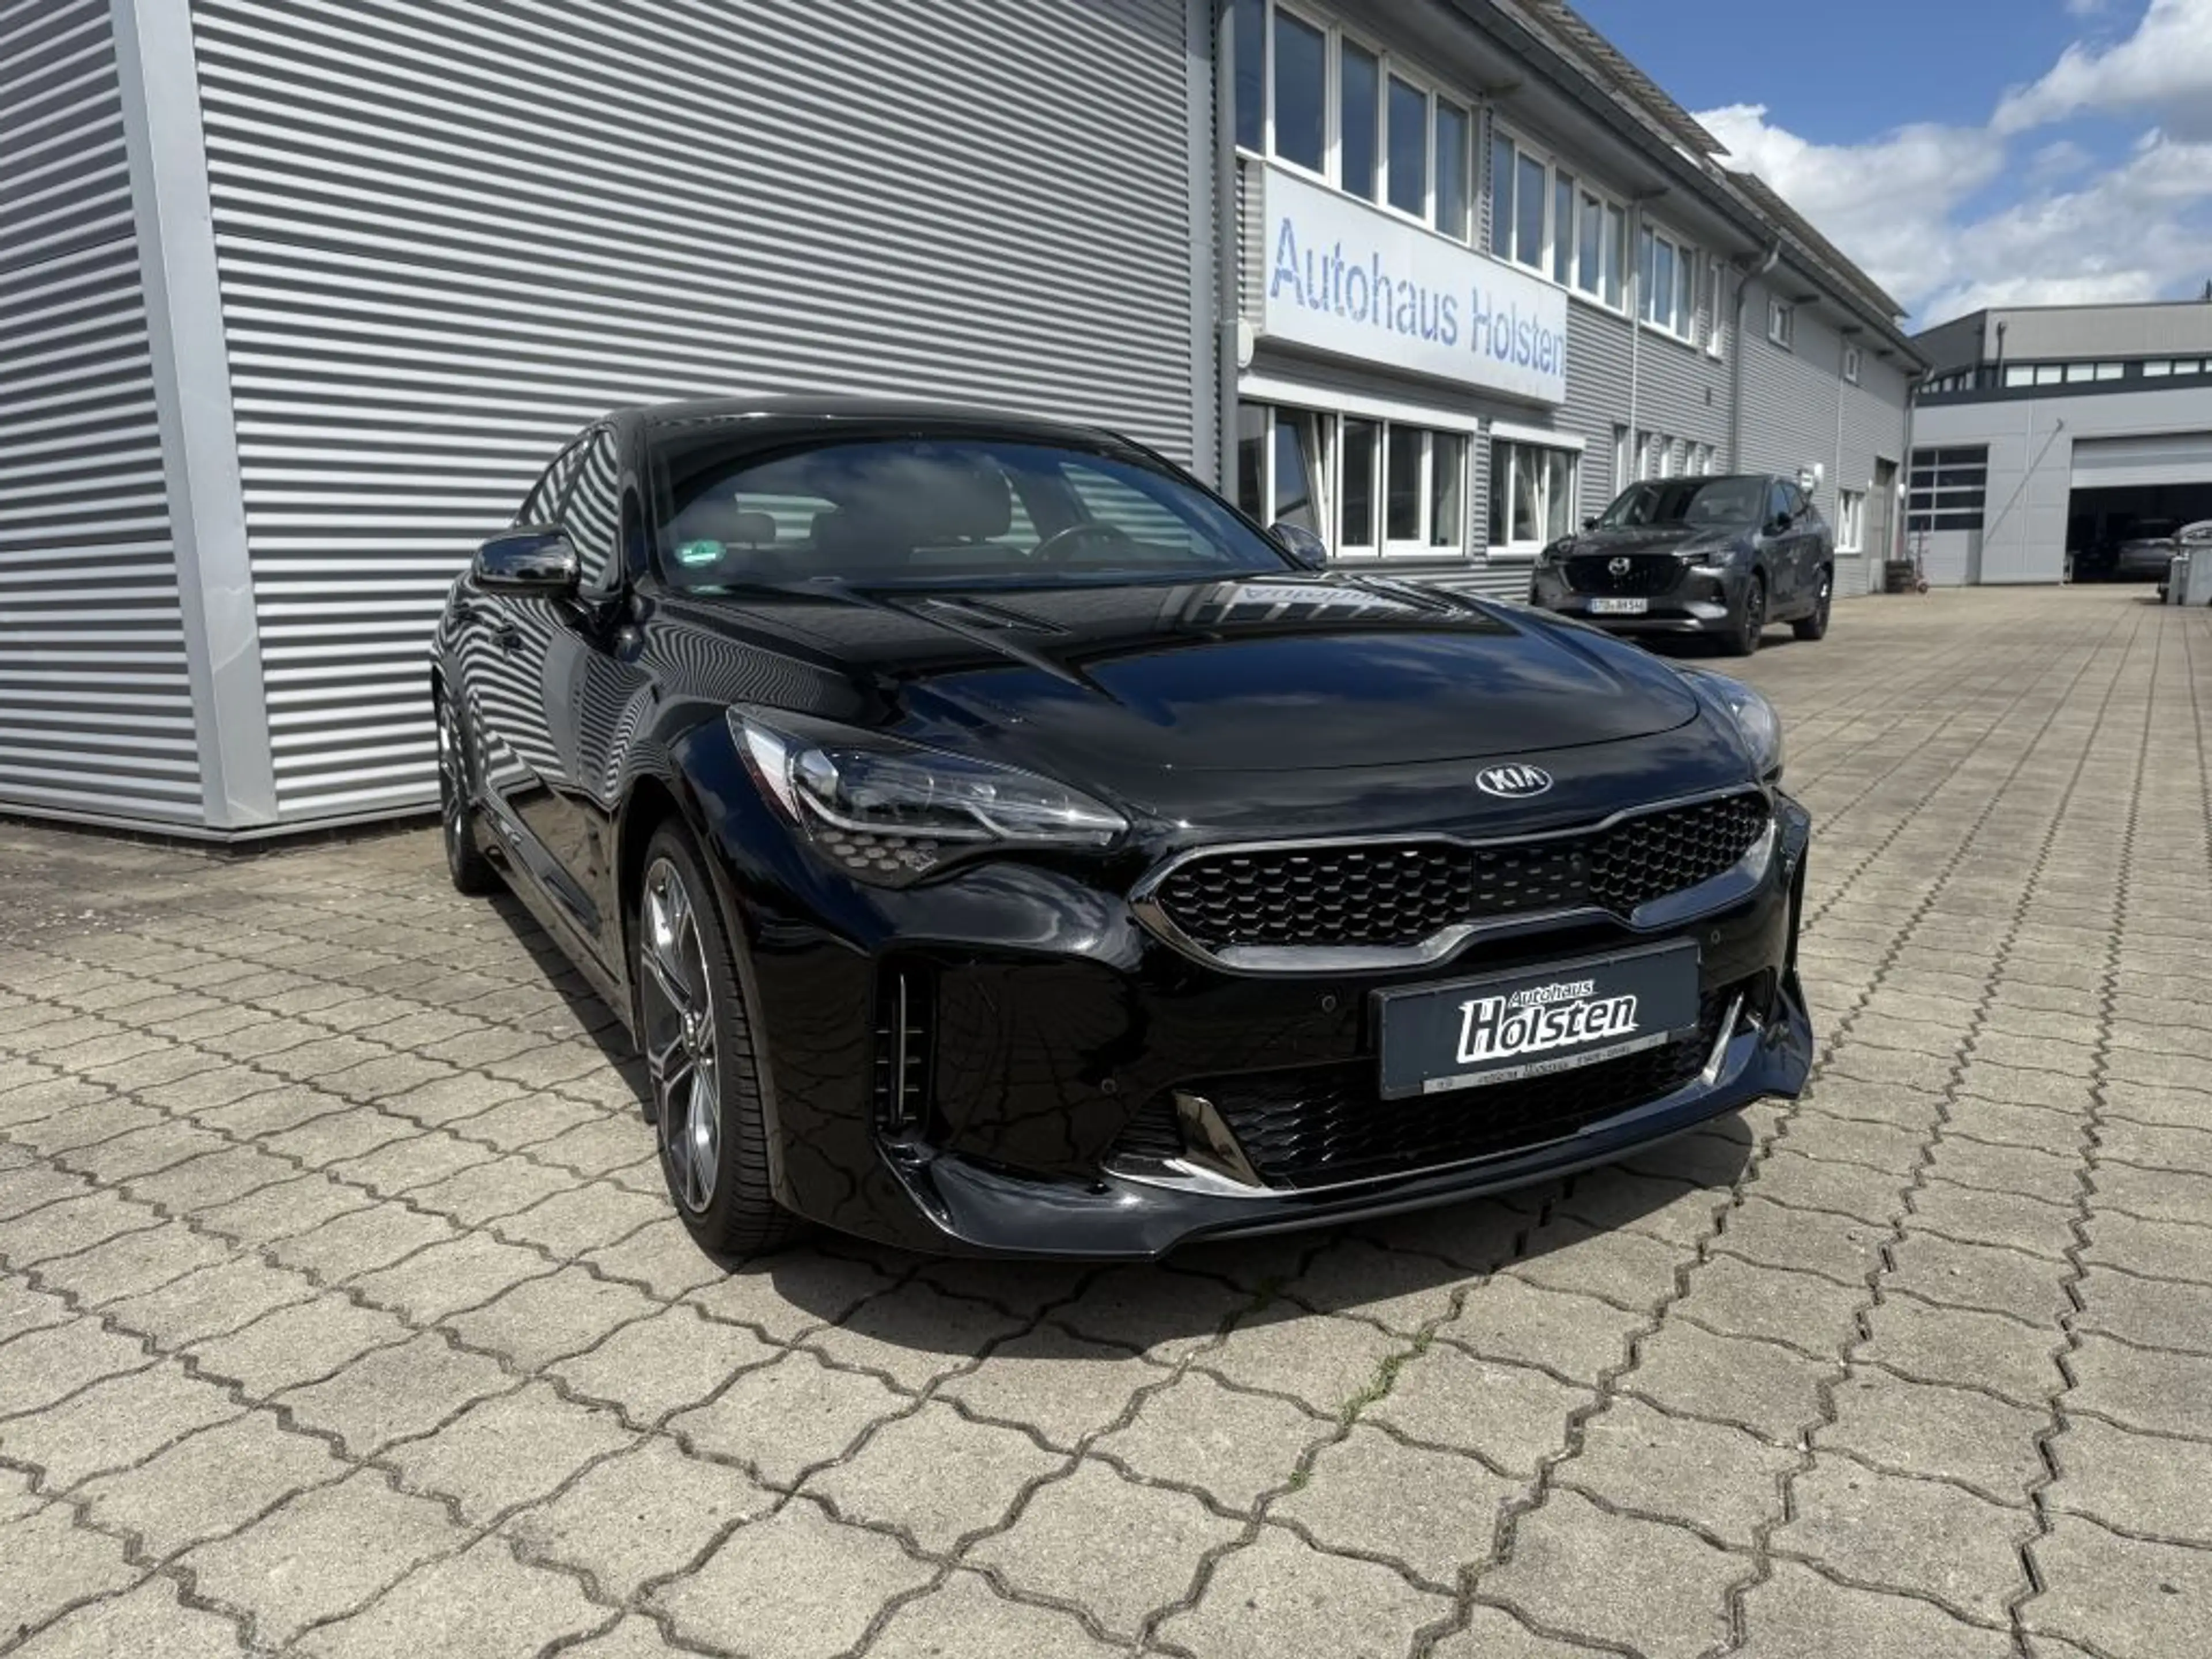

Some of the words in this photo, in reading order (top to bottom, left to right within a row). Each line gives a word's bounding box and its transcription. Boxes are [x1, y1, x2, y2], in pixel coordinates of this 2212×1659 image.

[1269, 217, 1458, 347] Autohaus
[1470, 286, 1565, 378] Holsten
[1486, 764, 1546, 790] KIA
[1507, 979, 1597, 1008] Autohaus
[1456, 995, 1640, 1064] Holsten
